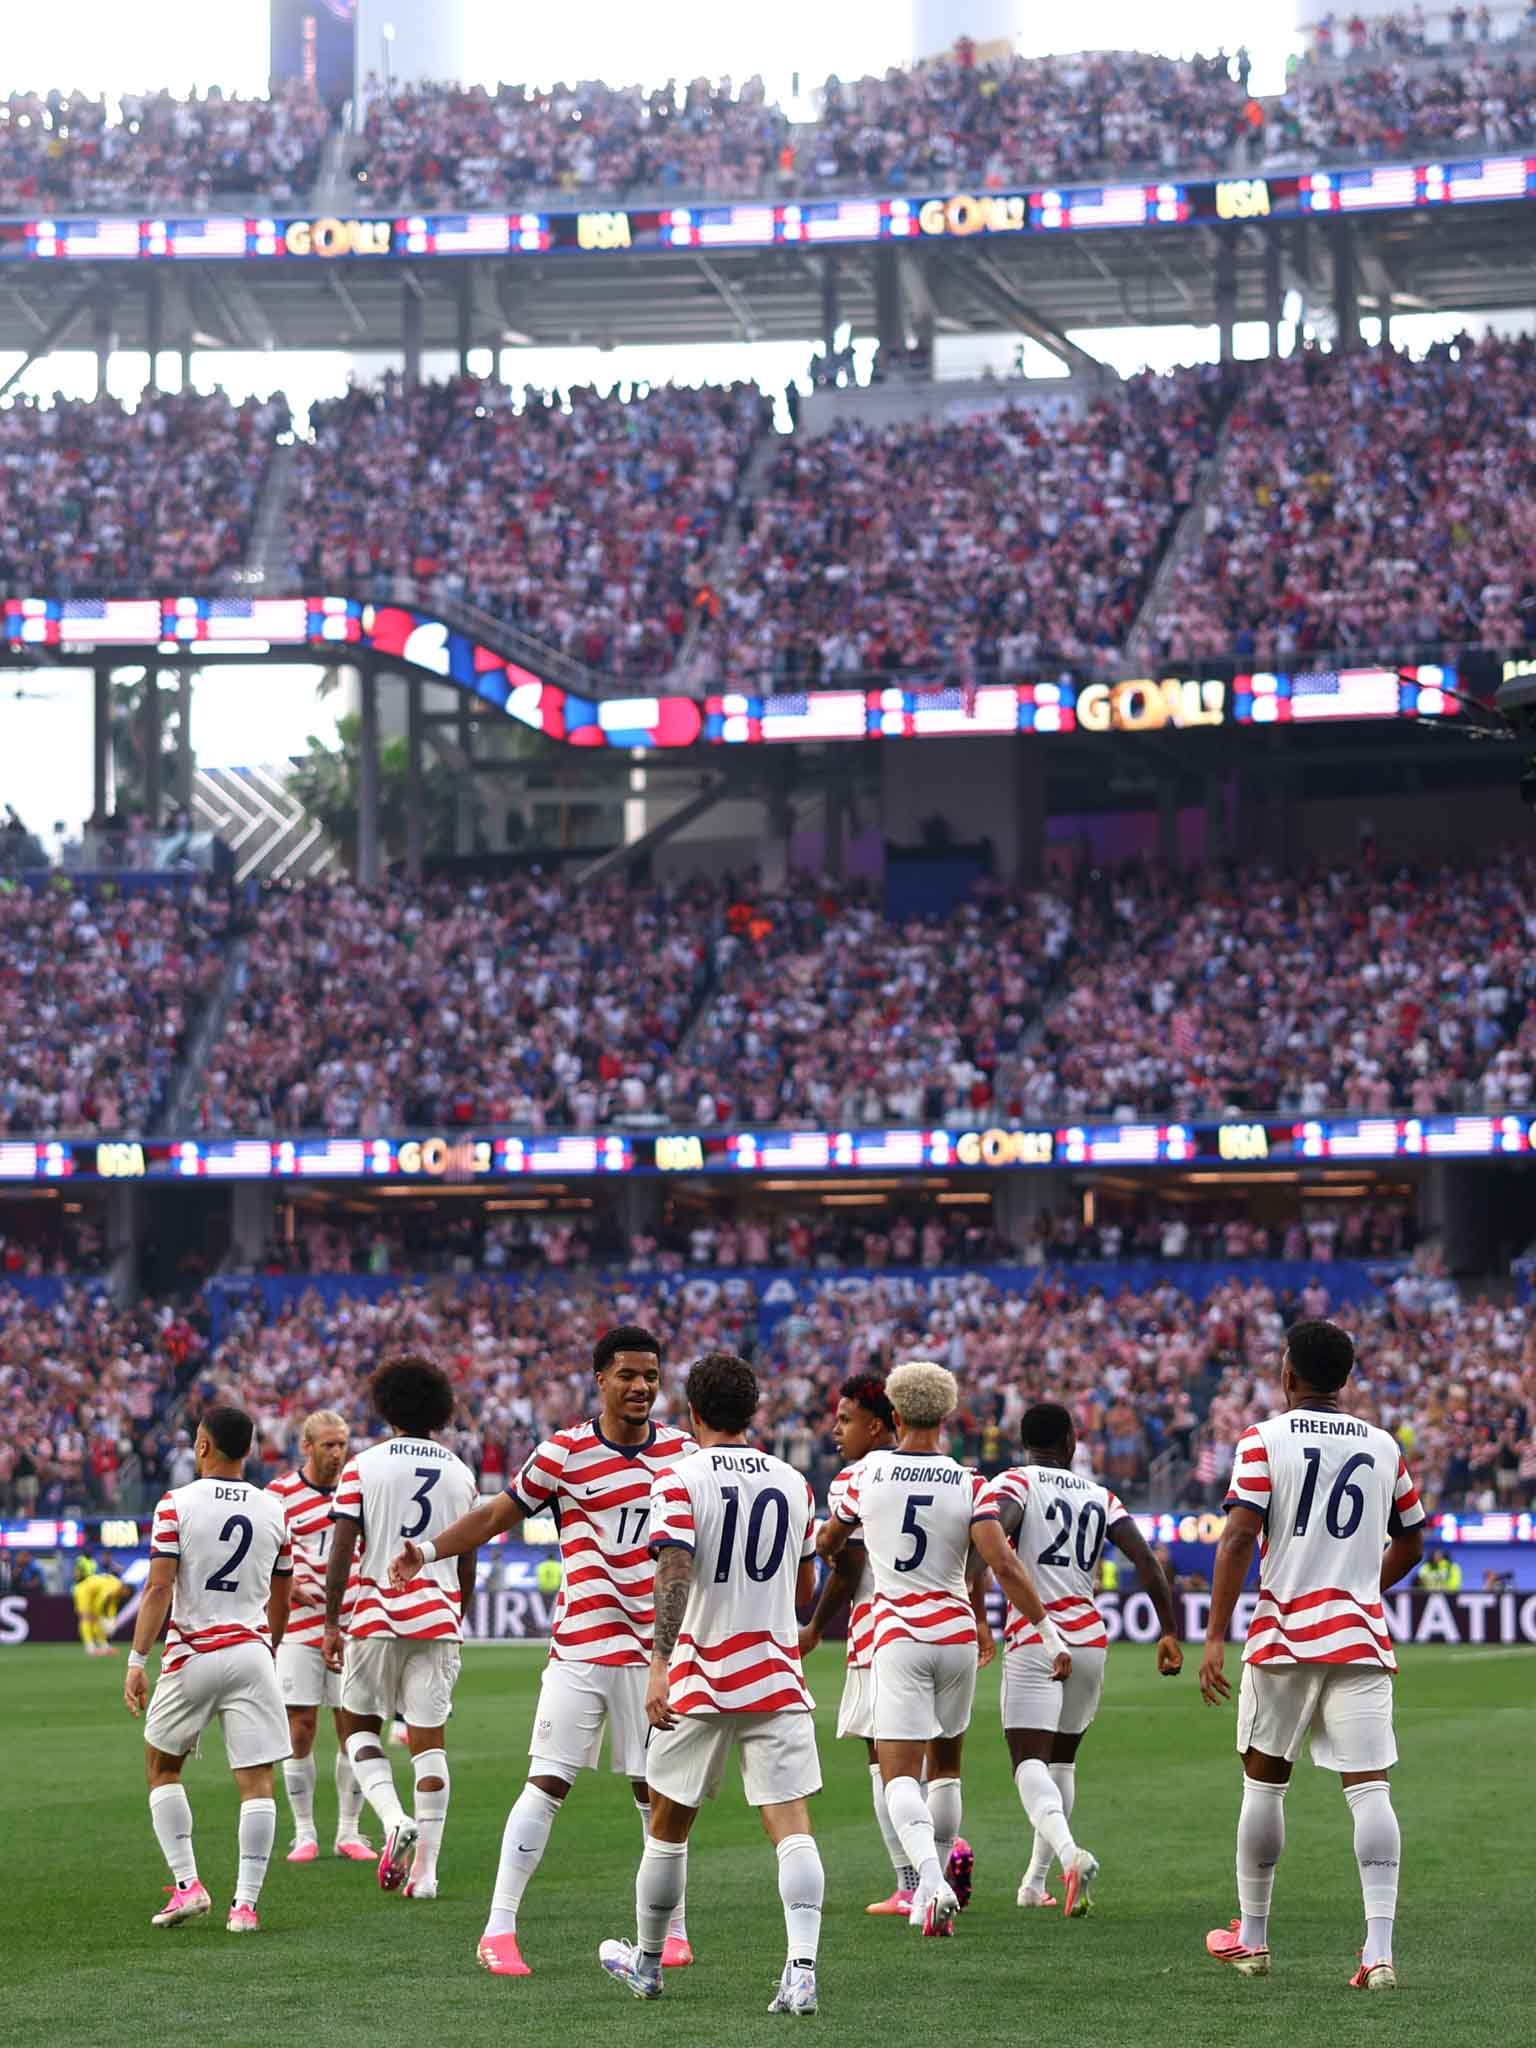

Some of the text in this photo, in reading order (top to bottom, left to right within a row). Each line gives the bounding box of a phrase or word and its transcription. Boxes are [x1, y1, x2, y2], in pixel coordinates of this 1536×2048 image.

[1076, 678, 1226, 731] GOAL!
[1290, 1418, 1368, 1438] FREEMAN
[215, 1486, 249, 1502] DEST
[711, 1455, 771, 1474] PULISIC
[890, 1466, 963, 1486] ROBINSON
[1293, 1447, 1375, 1540] 16
[400, 1467, 441, 1538] 3
[616, 1507, 650, 1544] 17
[894, 1495, 934, 1572] 5
[204, 1514, 253, 1592] 2
[714, 1486, 789, 1583] 10
[1038, 1497, 1106, 1572] 20
